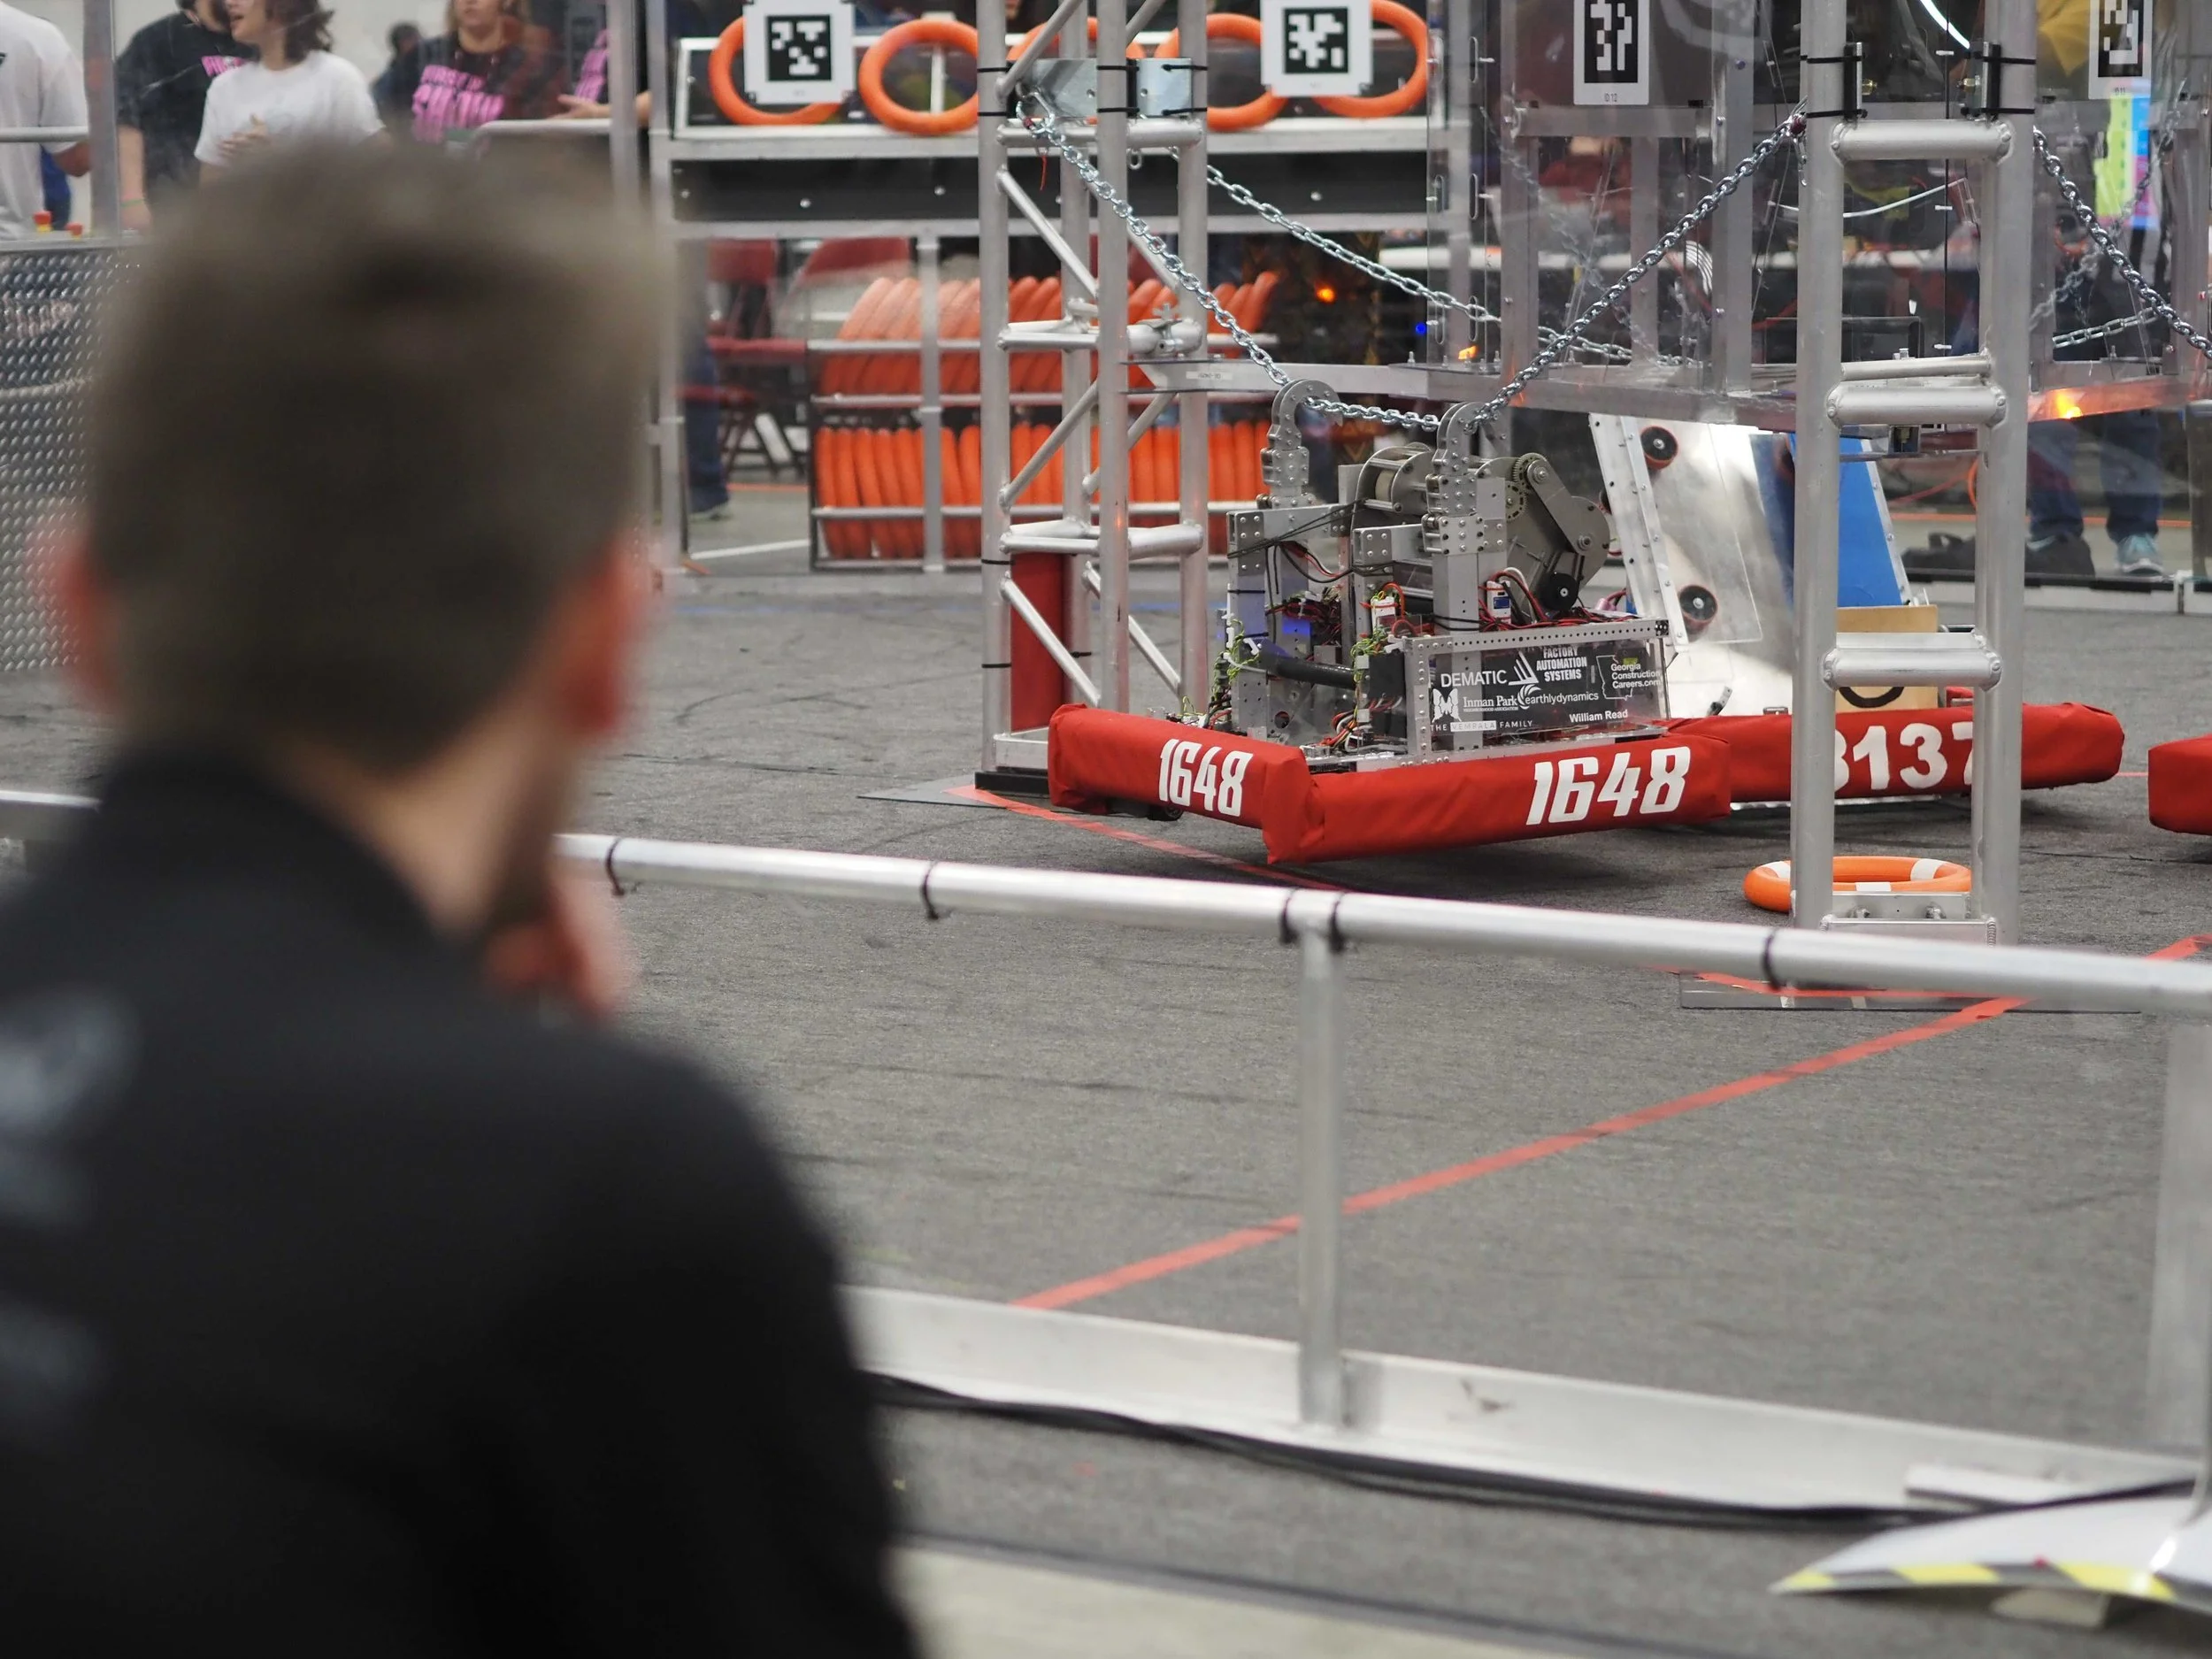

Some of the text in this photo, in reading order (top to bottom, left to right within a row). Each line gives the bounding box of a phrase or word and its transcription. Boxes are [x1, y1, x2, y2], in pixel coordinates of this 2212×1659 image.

[1543, 646, 1578, 658] FACTORY
[1536, 657, 1587, 671] AUTOMATION
[1610, 663, 1641, 672] Georgia
[1440, 670, 1508, 687] DEMATIC
[1544, 669, 1582, 682] SYSTEMS
[1611, 670, 1661, 680] Construction
[1612, 680, 1662, 688] Careers.com
[1463, 695, 1518, 708] Inman Park
[1525, 692, 1599, 705] earthlydynamics
[1569, 710, 1629, 723] William Read
[1159, 738, 1254, 818] 1648
[1525, 746, 1691, 826] 1648
